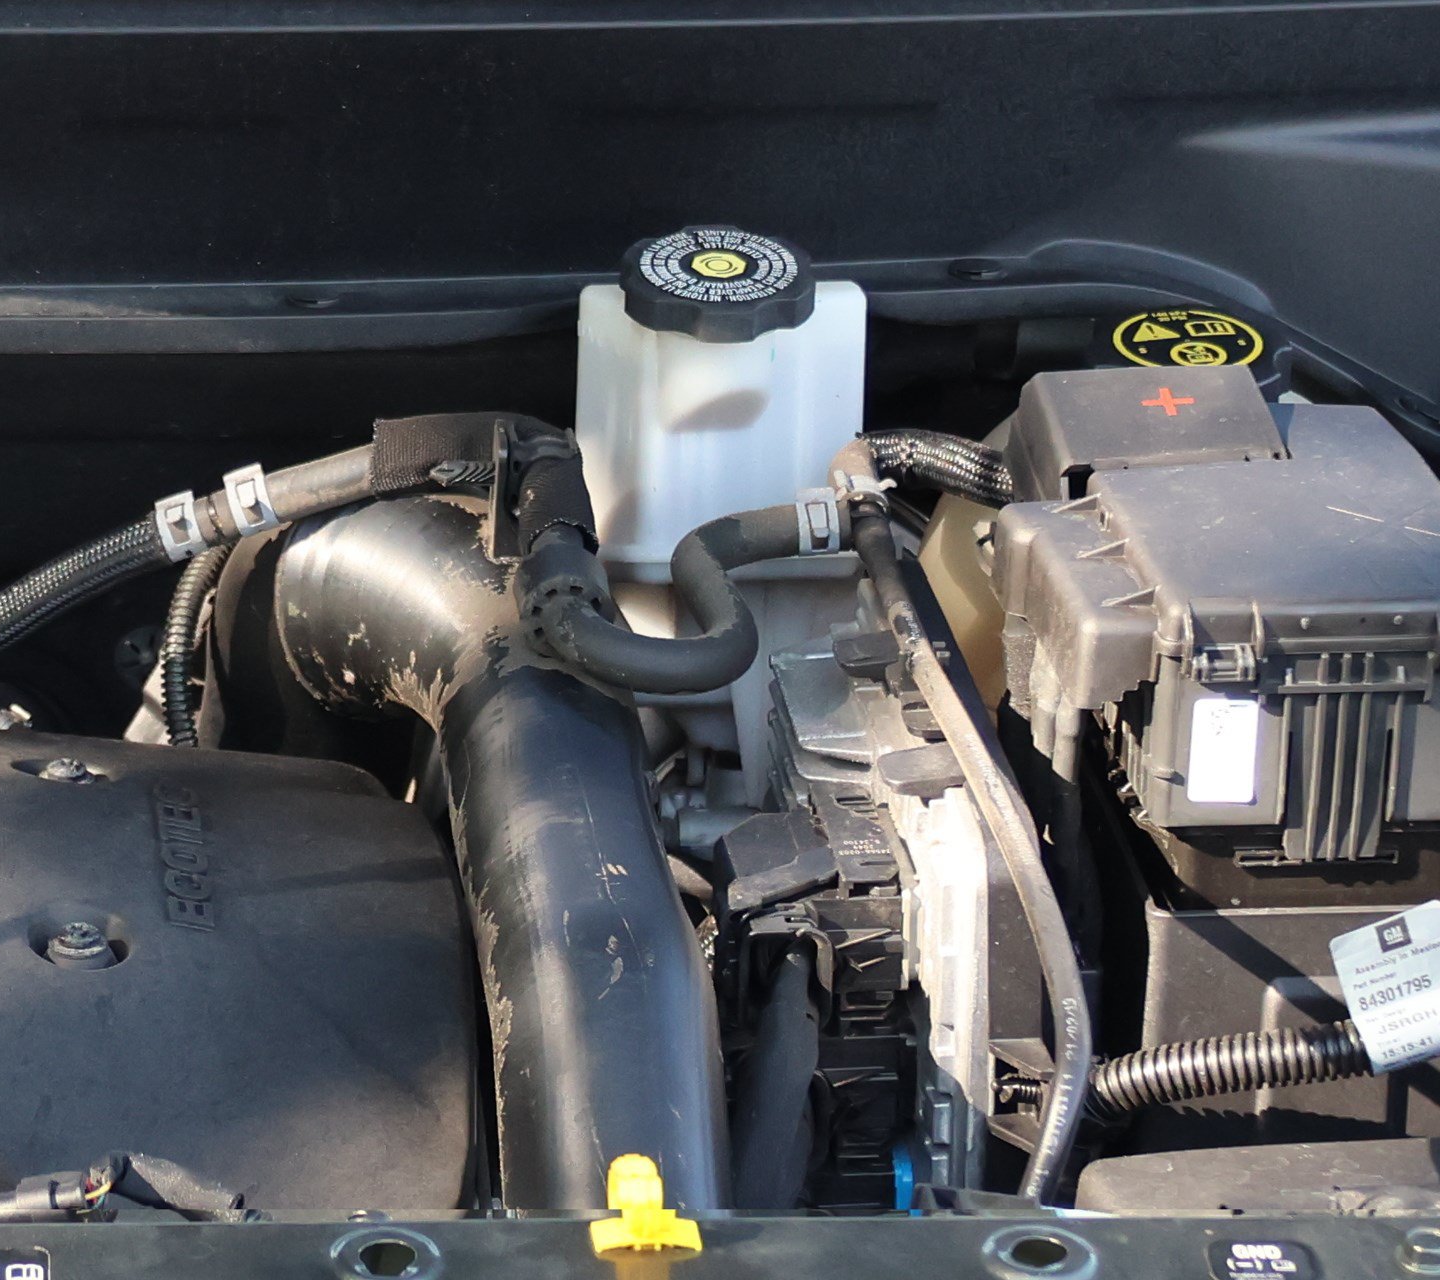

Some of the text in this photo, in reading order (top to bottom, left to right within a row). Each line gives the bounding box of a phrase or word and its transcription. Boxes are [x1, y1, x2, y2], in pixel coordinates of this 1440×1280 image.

[693, 230, 749, 240] CONTAINER.
[723, 236, 742, 244] USE
[750, 236, 782, 250] SEALED
[736, 247, 763, 258] CLEAN
[662, 284, 673, 292] LE
[673, 279, 688, 288] DU
[697, 278, 754, 288] PROVENANT
[687, 285, 708, 293] QUE
[674, 290, 721, 302] NETTOYER
[153, 781, 215, 932] ECOTEC
[1355, 956, 1397, 975] Assembly
[1358, 974, 1432, 1011] 84301795
[1231, 1243, 1282, 1260] GND
